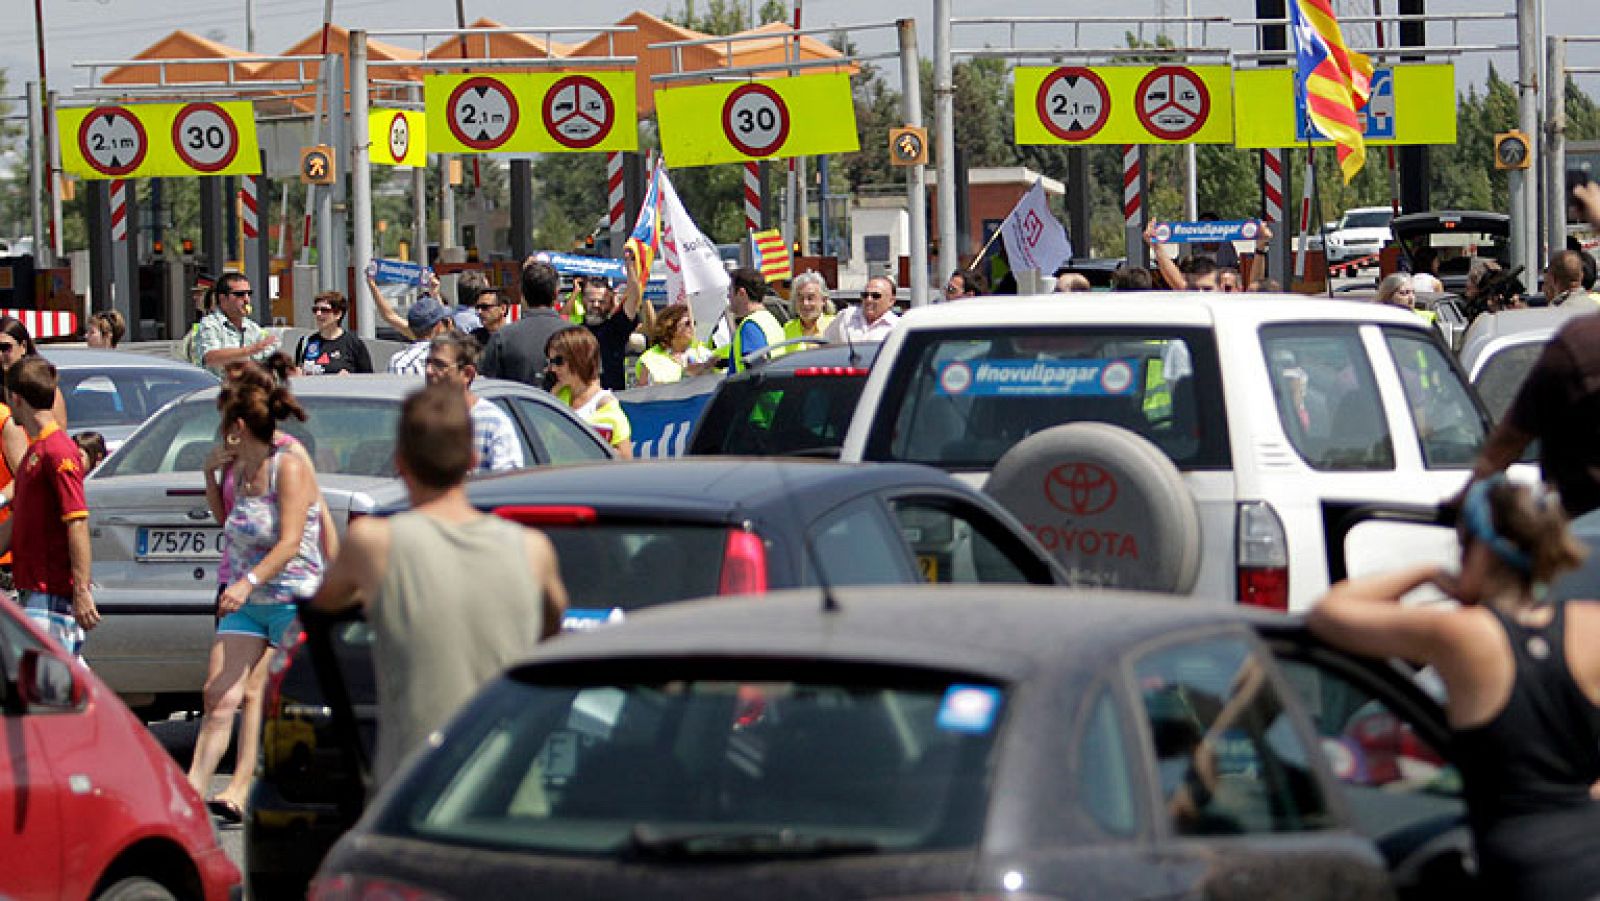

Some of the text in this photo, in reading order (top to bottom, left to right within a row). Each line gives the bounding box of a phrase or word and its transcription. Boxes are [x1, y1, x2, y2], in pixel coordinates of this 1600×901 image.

[737, 107, 775, 132] 30
[187, 125, 224, 149] 30
[151, 531, 205, 553] 7576
